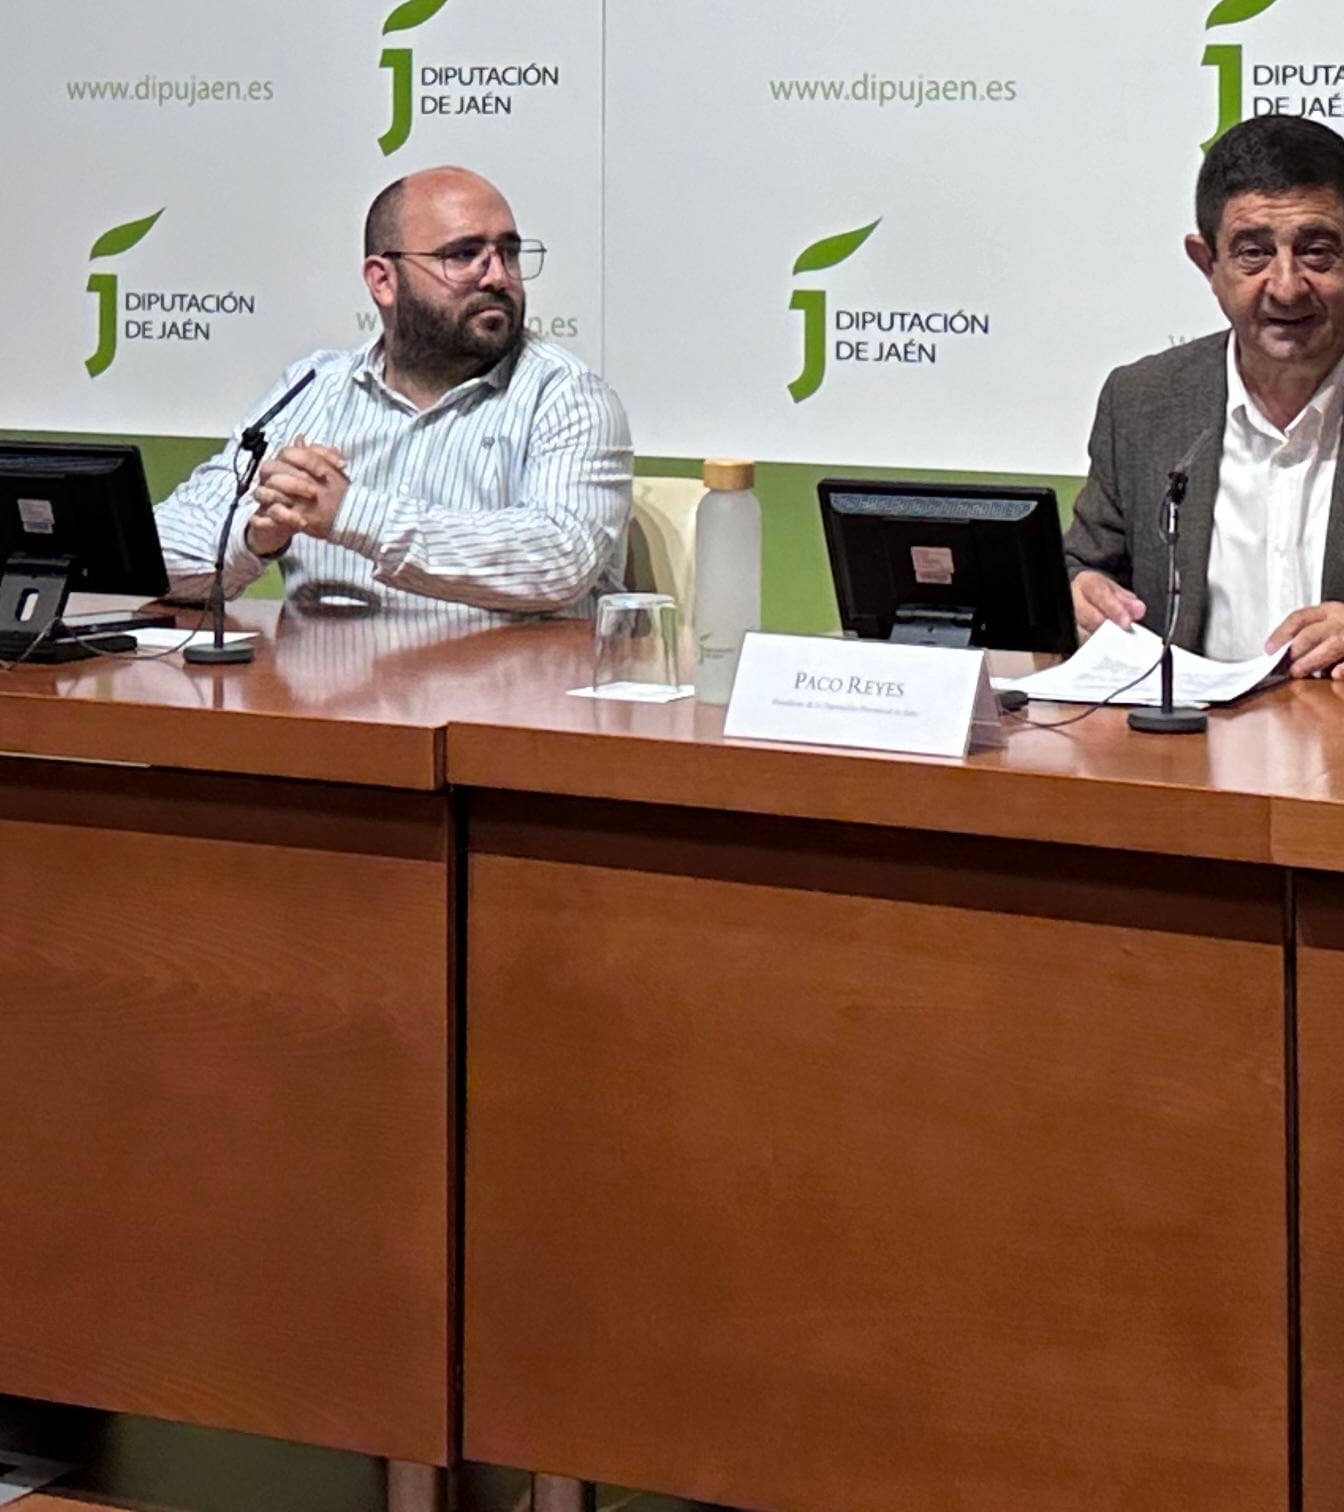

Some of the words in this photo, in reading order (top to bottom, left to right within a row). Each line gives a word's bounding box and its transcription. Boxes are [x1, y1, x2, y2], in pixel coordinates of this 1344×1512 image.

[421, 63, 559, 86] DIPUTACIÓN
[66, 75, 274, 107] www.dipujaen.es
[769, 72, 1017, 108] www.dipujaen.es
[421, 95, 450, 115] DE
[455, 94, 512, 115] JAÉN
[1252, 95, 1291, 117] DE
[125, 291, 255, 314] DIPUTACIÓN
[124, 321, 153, 340] DE
[158, 319, 210, 341] JAÉN
[835, 310, 989, 335] DIPUTACIÓN
[835, 343, 868, 362] DE
[874, 339, 936, 364] JAÉN
